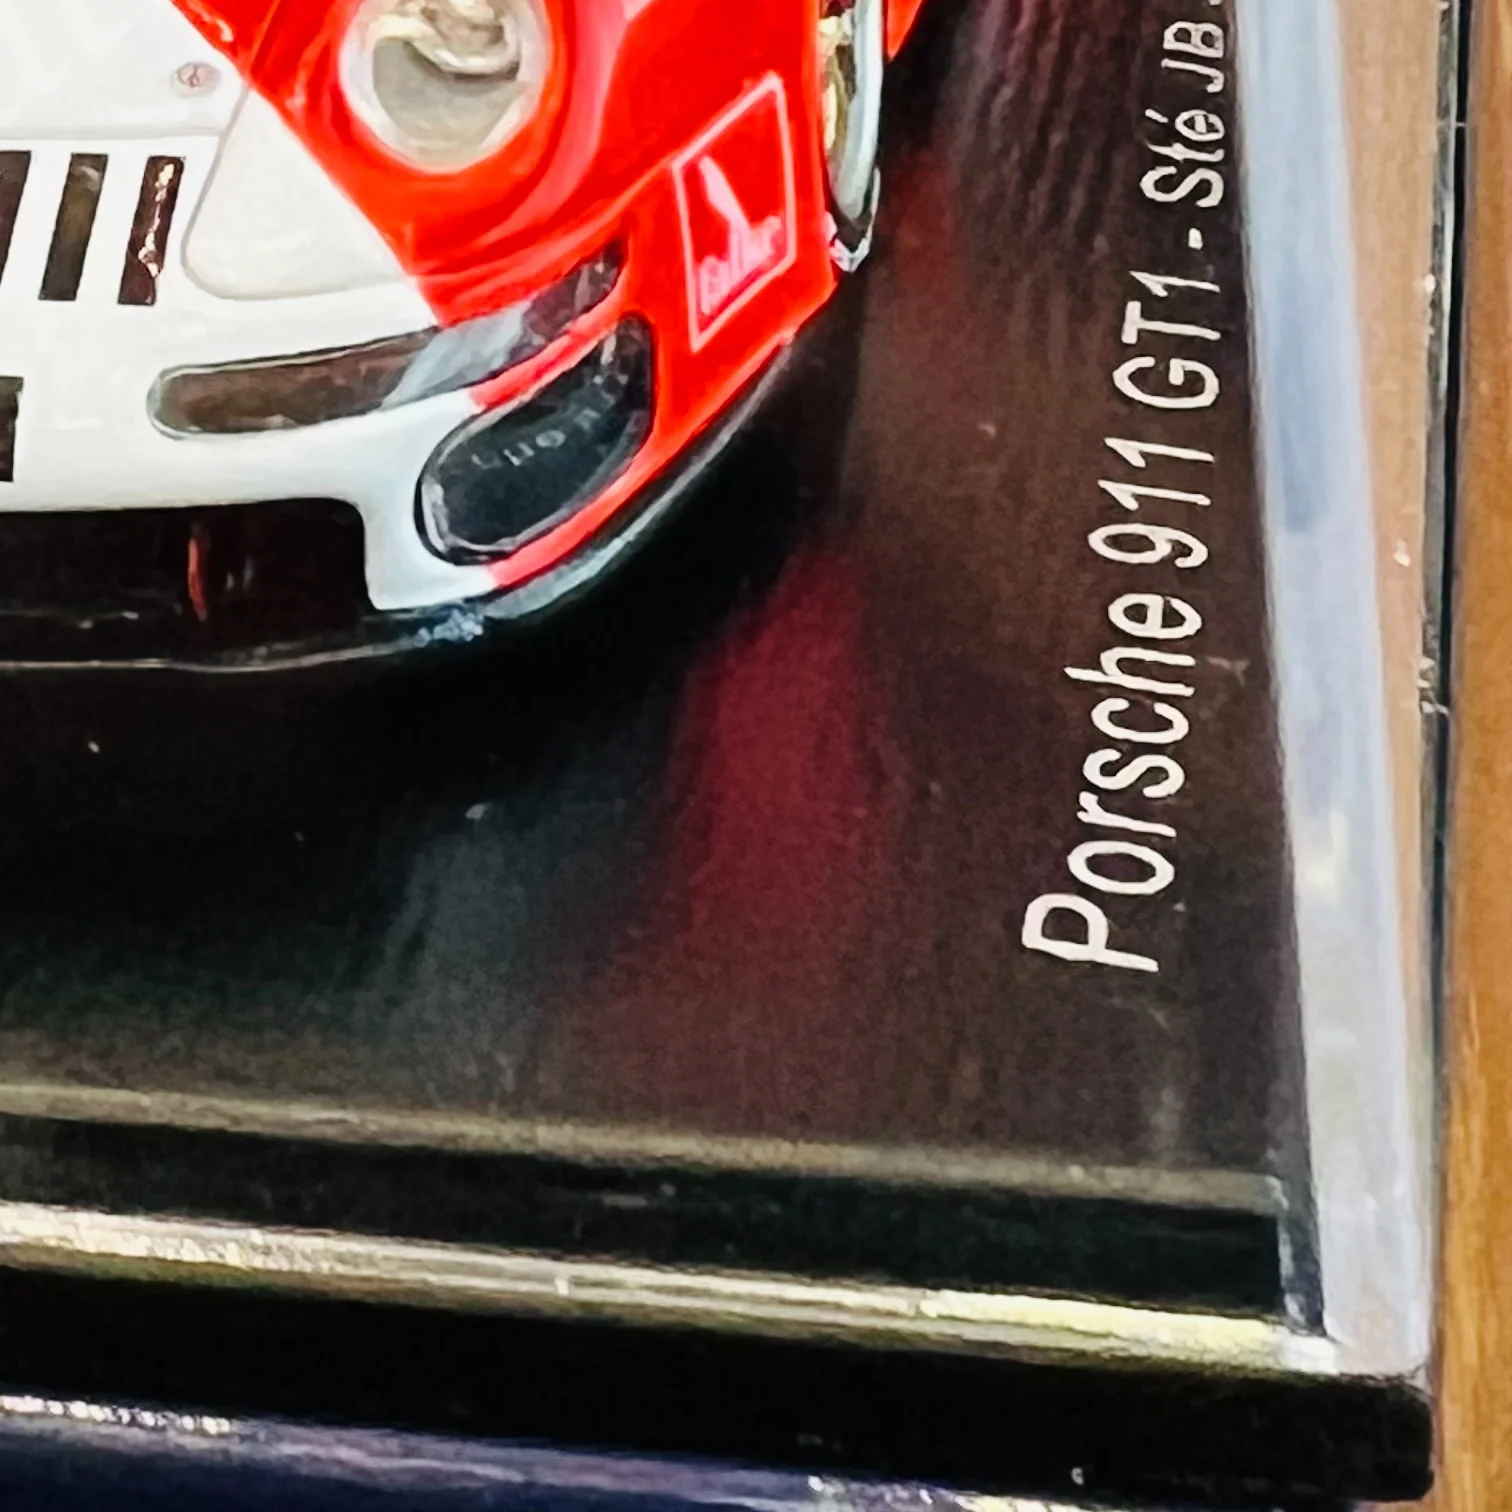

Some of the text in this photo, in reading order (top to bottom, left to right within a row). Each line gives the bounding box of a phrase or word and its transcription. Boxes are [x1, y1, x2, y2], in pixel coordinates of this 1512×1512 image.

[1160, 20, 1226, 94] JB
[1139, 107, 1226, 208] Sté
[1112, 270, 1221, 410] GT1
[1087, 437, 1215, 568] 911
[1021, 591, 1203, 972] Porsche
